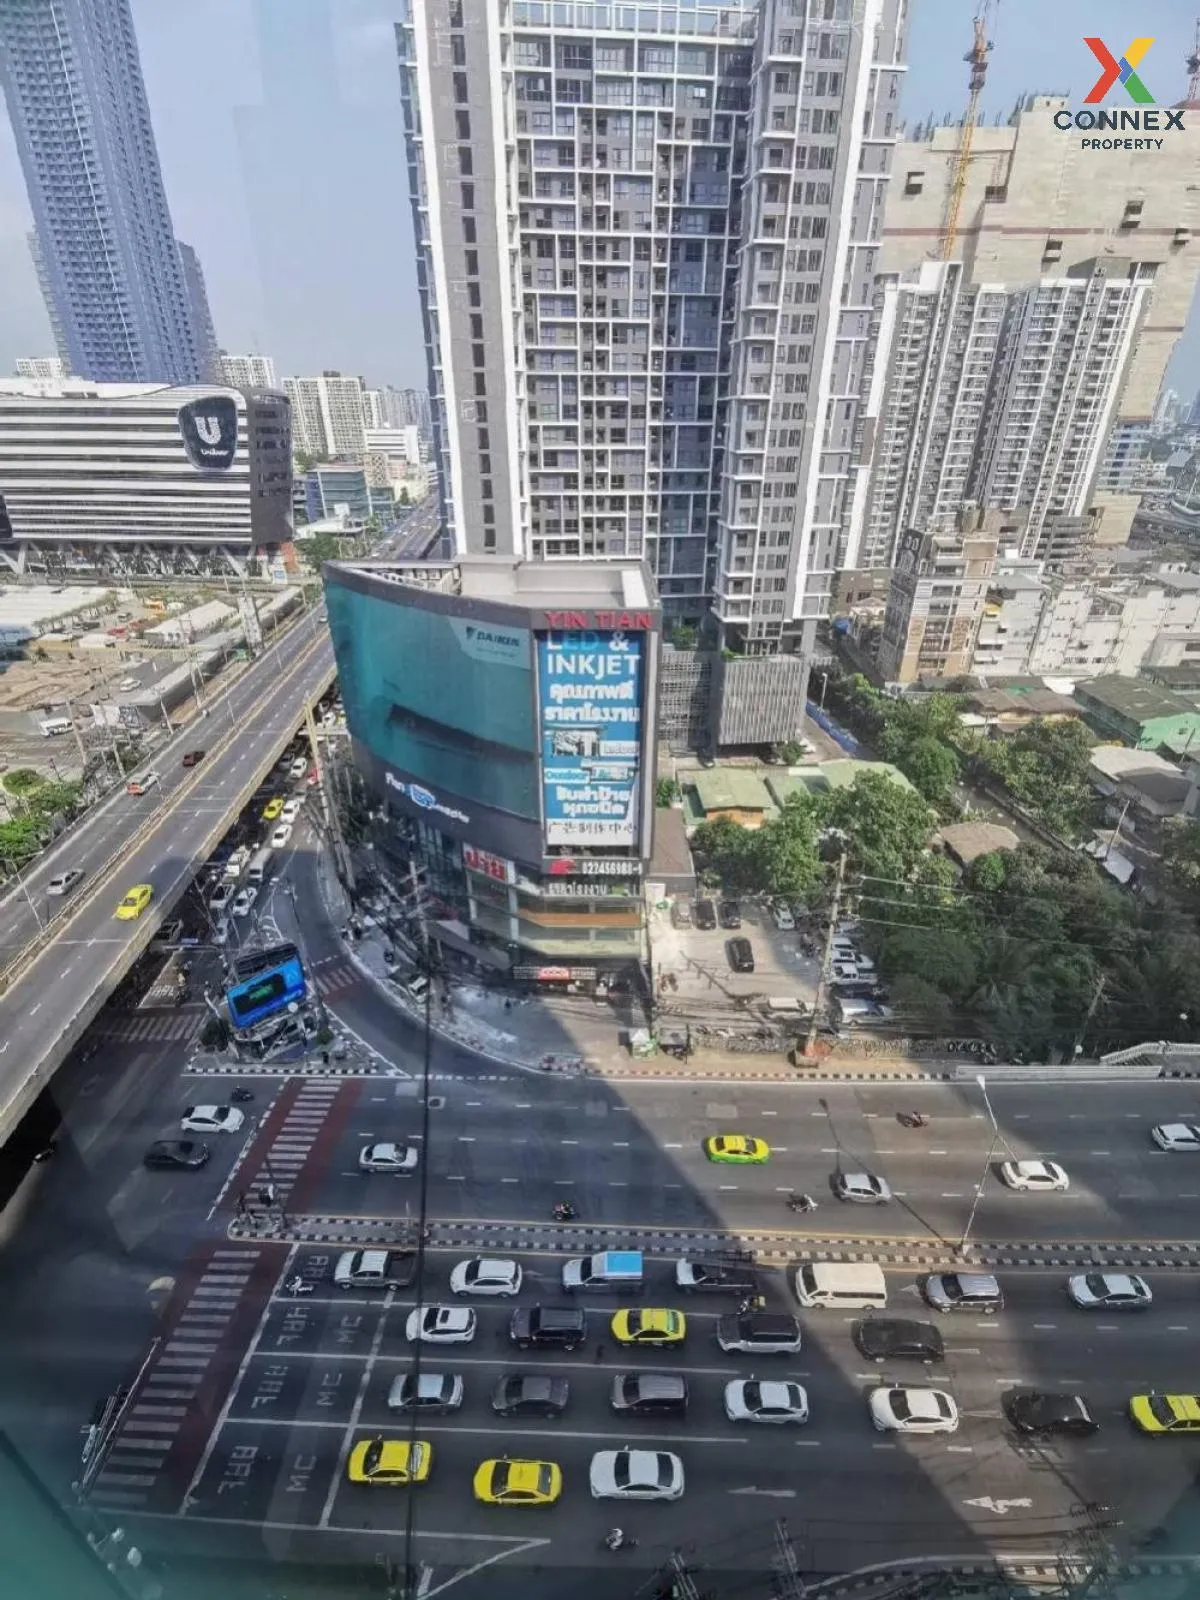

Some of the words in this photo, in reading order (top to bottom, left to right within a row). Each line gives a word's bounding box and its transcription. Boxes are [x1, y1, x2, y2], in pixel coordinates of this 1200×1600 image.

[194, 416, 222, 445] U
[545, 610, 591, 630] YIN
[594, 610, 653, 630] TIAN
[546, 630, 600, 651] LED
[608, 631, 630, 651] &
[547, 653, 641, 680] INKJET
[285, 1454, 318, 1493] MC
